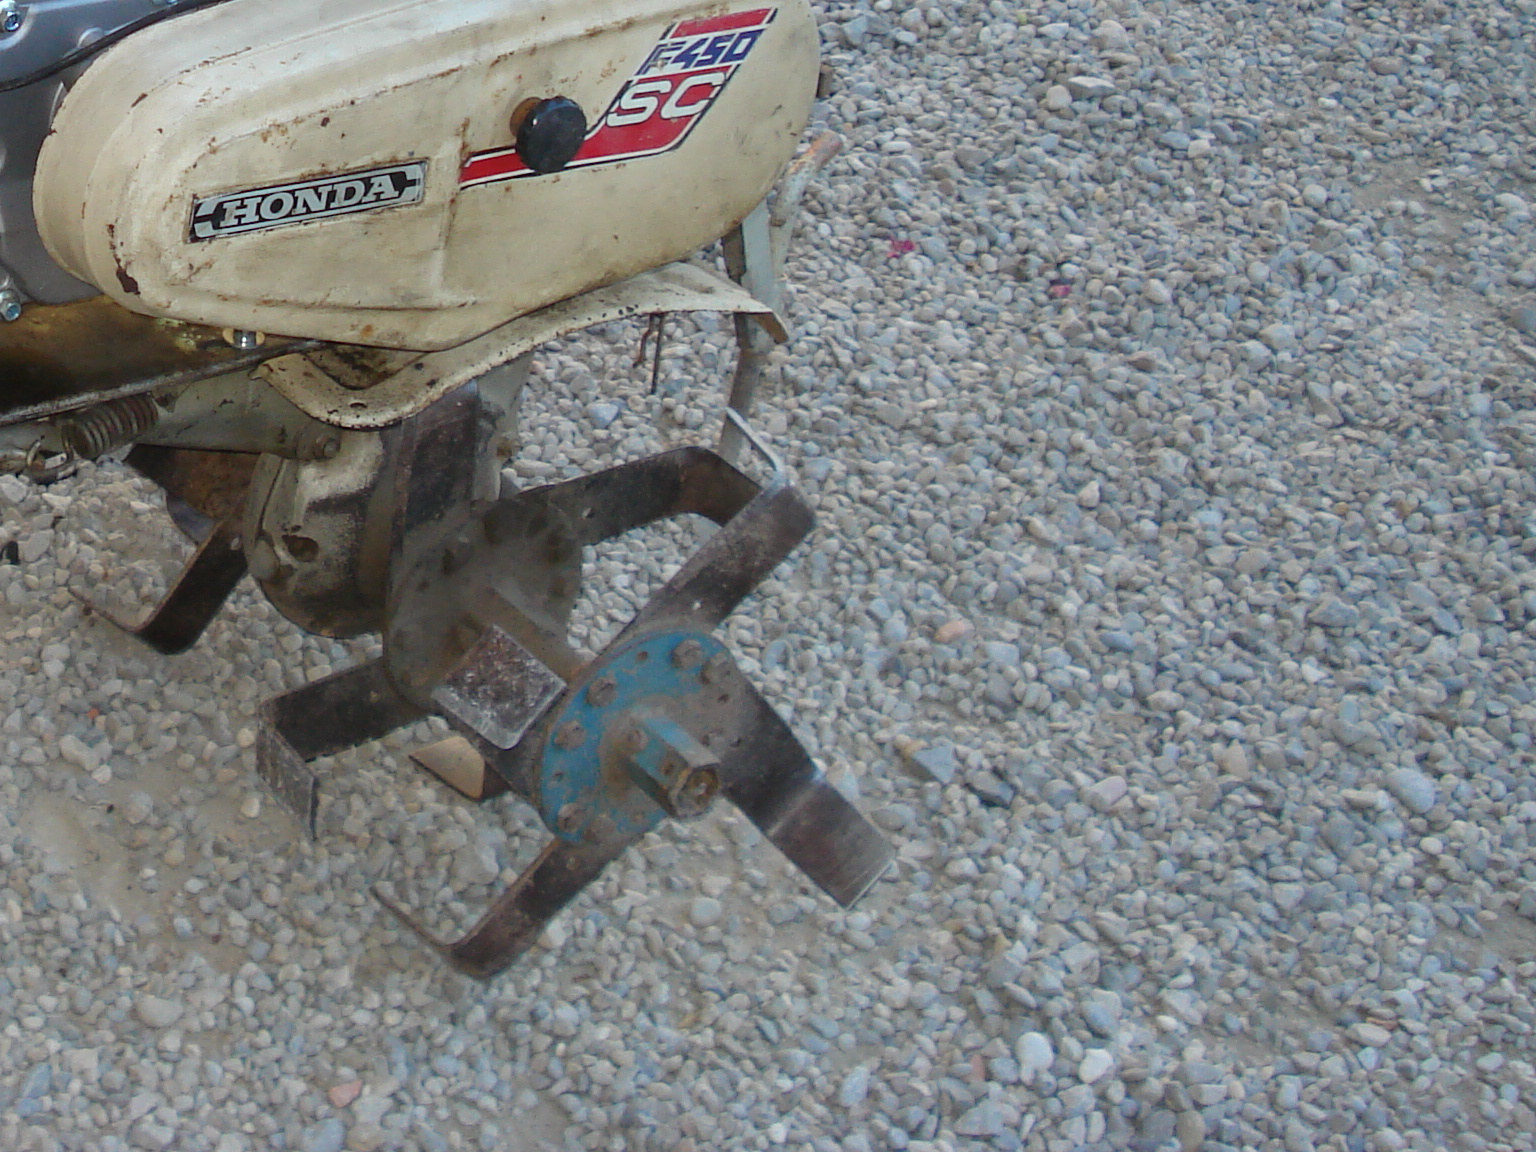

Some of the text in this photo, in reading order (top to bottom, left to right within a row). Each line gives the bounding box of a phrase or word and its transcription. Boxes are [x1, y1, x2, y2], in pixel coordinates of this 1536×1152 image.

[635, 28, 767, 76] F450
[605, 72, 727, 127] SC
[220, 174, 399, 228] HONDA
